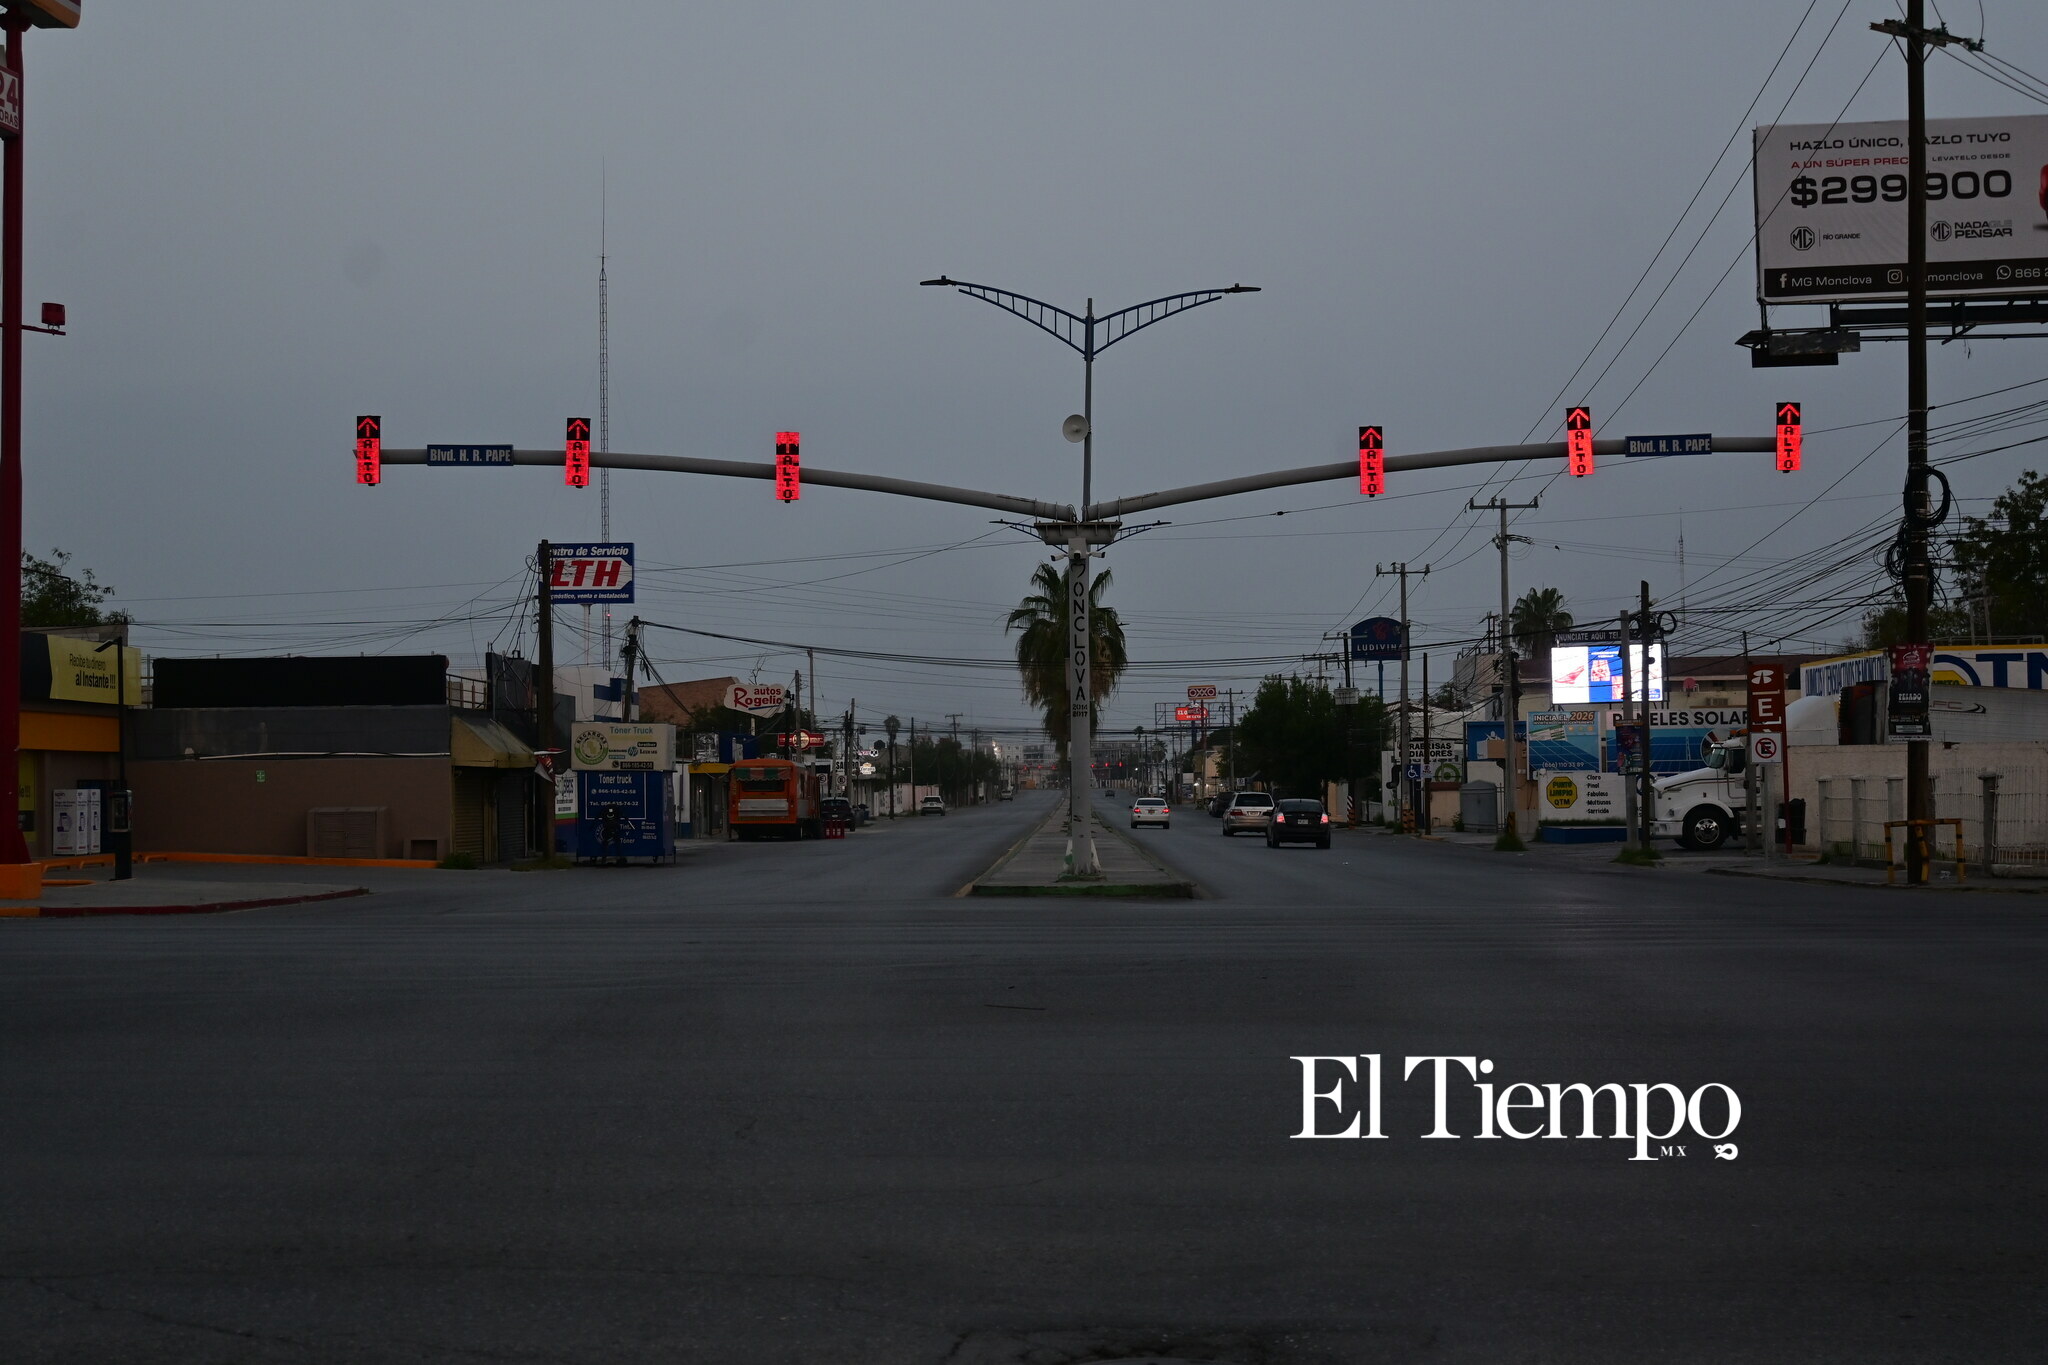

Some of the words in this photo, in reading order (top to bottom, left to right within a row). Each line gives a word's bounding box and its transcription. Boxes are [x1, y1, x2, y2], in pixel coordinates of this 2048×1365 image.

[1790, 139, 1844, 151] HAZLO
[1849, 137, 1903, 149] ÚNICO,
[1908, 135, 1962, 146] AZLO
[1966, 132, 2011, 143] TUYO
[1791, 161, 1800, 169] A
[1803, 160, 1822, 168] UN
[1826, 158, 1870, 168] SÚPER
[1873, 157, 1909, 165] PREC
[1980, 152, 2011, 160] DESDE
[1792, 228, 1813, 249] MG
[1835, 232, 1861, 240] GRANDE
[1954, 228, 2012, 239] PENSAR
[1791, 277, 1813, 288] MG
[1816, 275, 1873, 287] Monclova
[2015, 267, 2041, 279] 866
[430, 448, 456, 462] Blvd.
[459, 448, 469, 462] H.
[473, 449, 482, 462] R.
[485, 449, 511, 462] PAPE
[1574, 431, 1587, 474] ALTO
[1629, 440, 1656, 453] Blvd.
[1659, 439, 1669, 452] H.
[1672, 439, 1682, 452] R.
[1685, 438, 1711, 452] PAPE
[1783, 426, 1794, 469] ALTO
[362, 440, 373, 483] ALTO
[572, 441, 582, 485] ALTO
[1366, 450, 1378, 493] ALTO
[576, 547, 588, 556] de
[591, 546, 629, 556] Servicio
[550, 560, 622, 587] LTH
[82, 671, 109, 689] Instante
[734, 687, 782, 708] Rogelio
[754, 687, 781, 695] autos
[1189, 687, 1215, 697] OXXO
[1569, 711, 1595, 721] 2026
